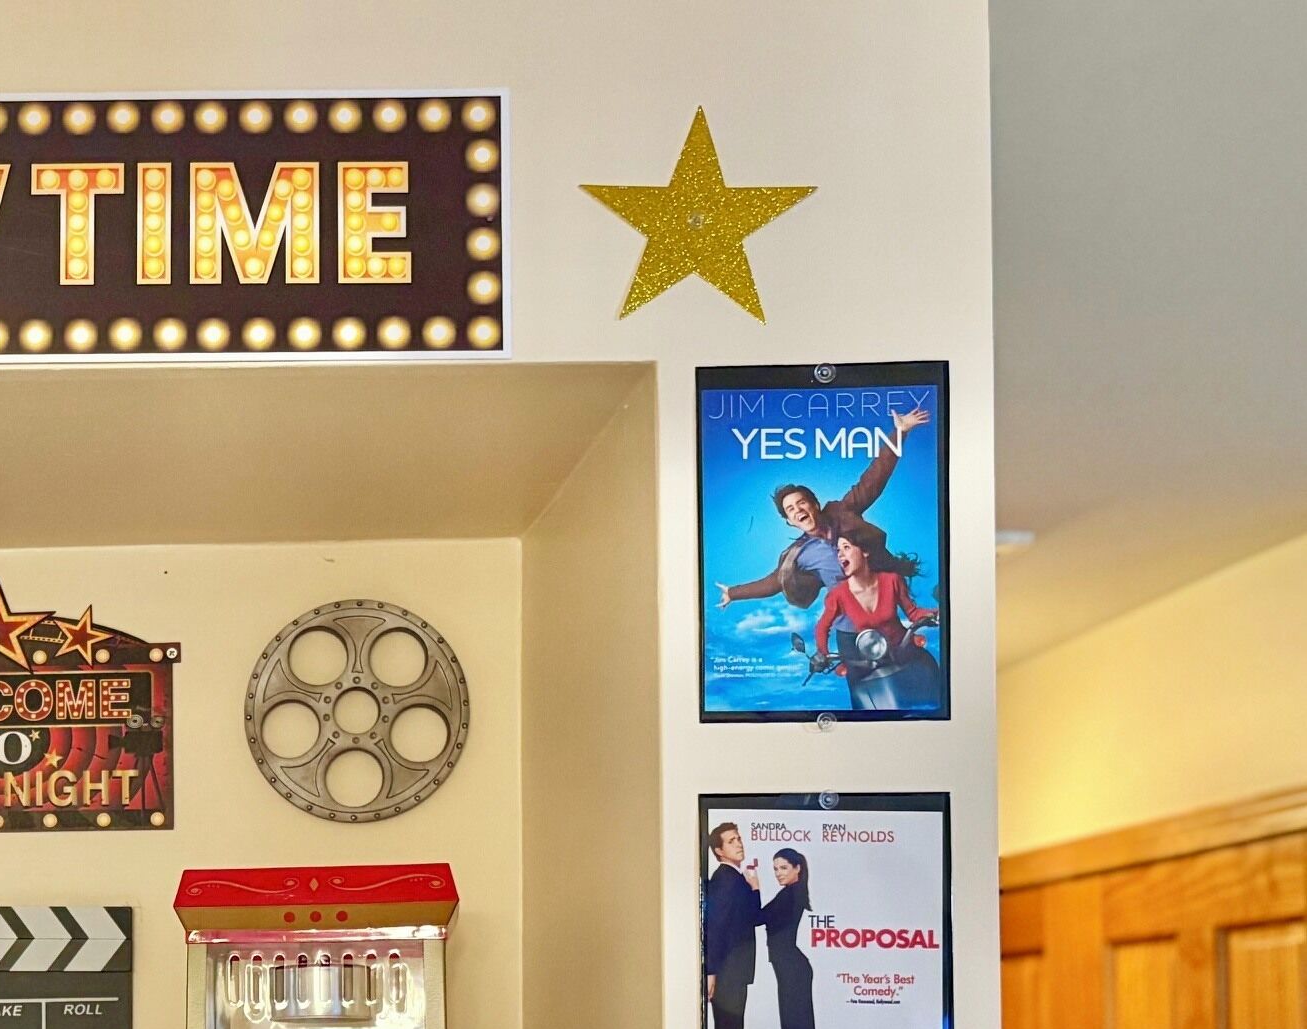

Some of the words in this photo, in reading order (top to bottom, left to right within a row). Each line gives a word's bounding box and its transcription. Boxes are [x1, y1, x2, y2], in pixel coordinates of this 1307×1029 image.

[709, 394, 764, 419] JIM
[782, 391, 930, 418] CARREY
[731, 428, 806, 460] YES
[815, 426, 902, 459] MAN
[3, 769, 139, 808] NIGHT
[822, 824, 846, 832] RYAN
[751, 830, 811, 842] BULLOCK
[822, 831, 895, 843] REYNOLDS
[809, 915, 835, 928] THE
[811, 928, 939, 949] PROPOSAL
[862, 973, 890, 985] Year's
[893, 974, 915, 985] Best
[63, 1004, 103, 1016] ROLL
